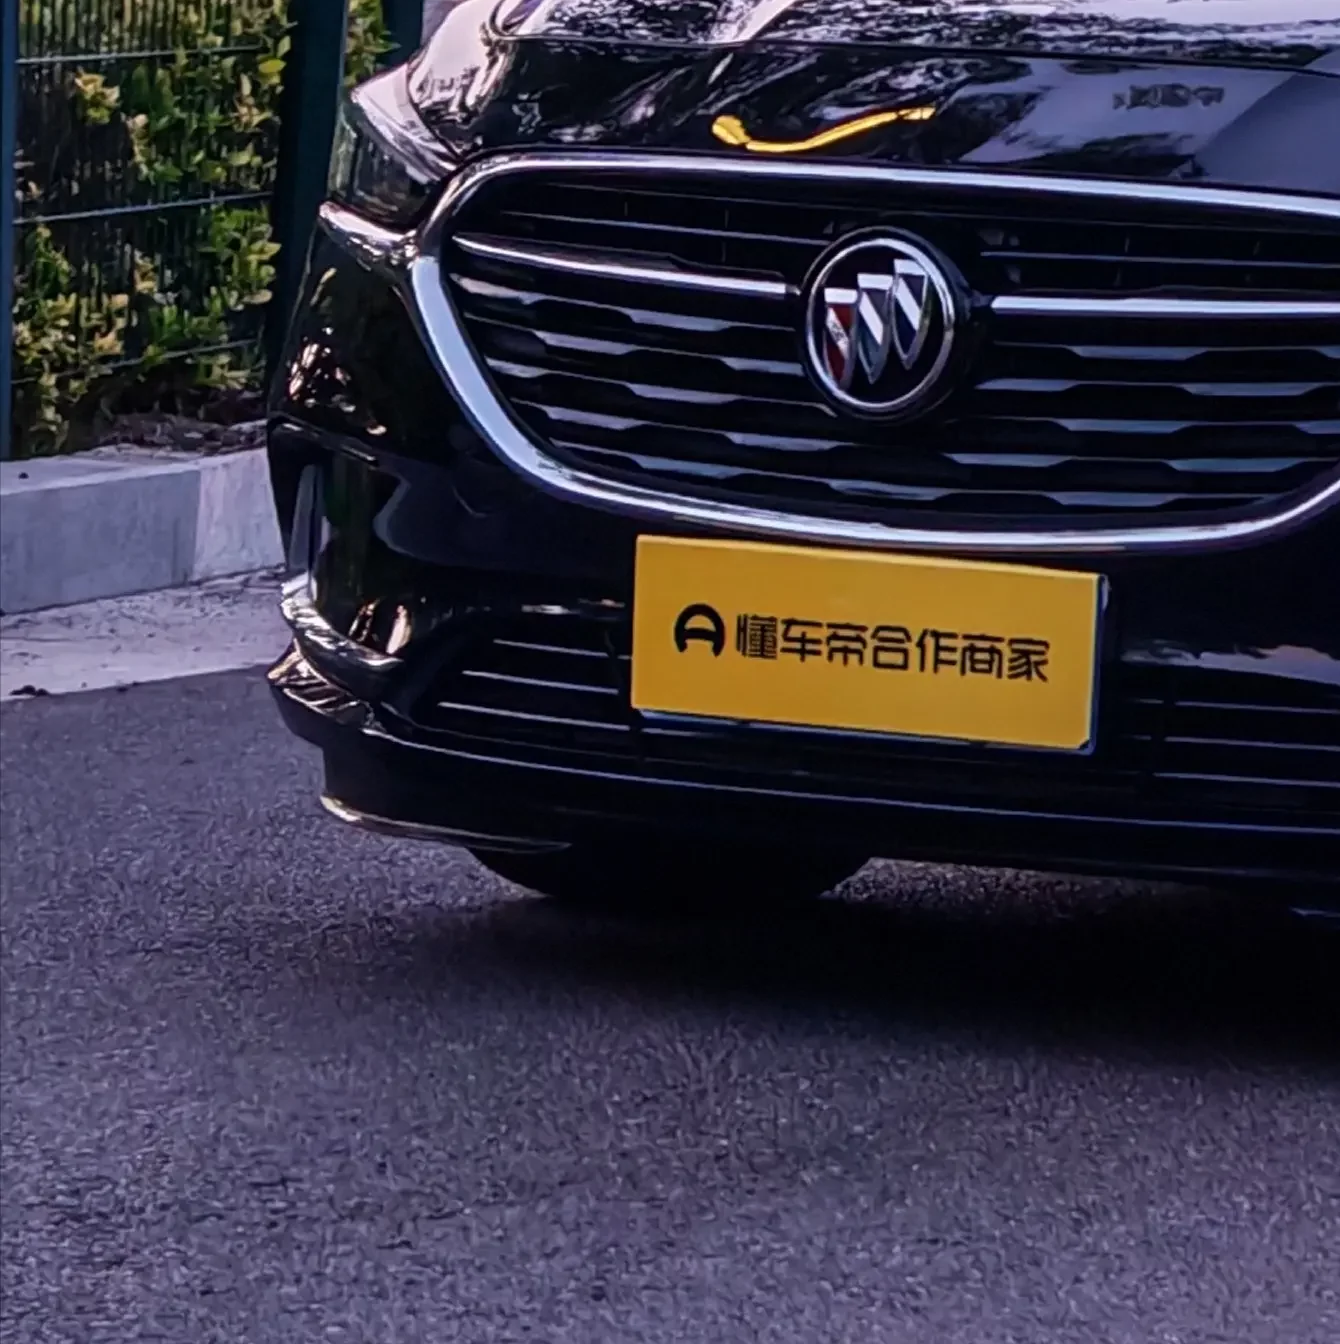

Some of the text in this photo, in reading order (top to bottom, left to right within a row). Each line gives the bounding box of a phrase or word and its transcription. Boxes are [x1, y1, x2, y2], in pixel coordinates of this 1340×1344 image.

[736, 613, 1050, 681] 懂车帝合作商家
